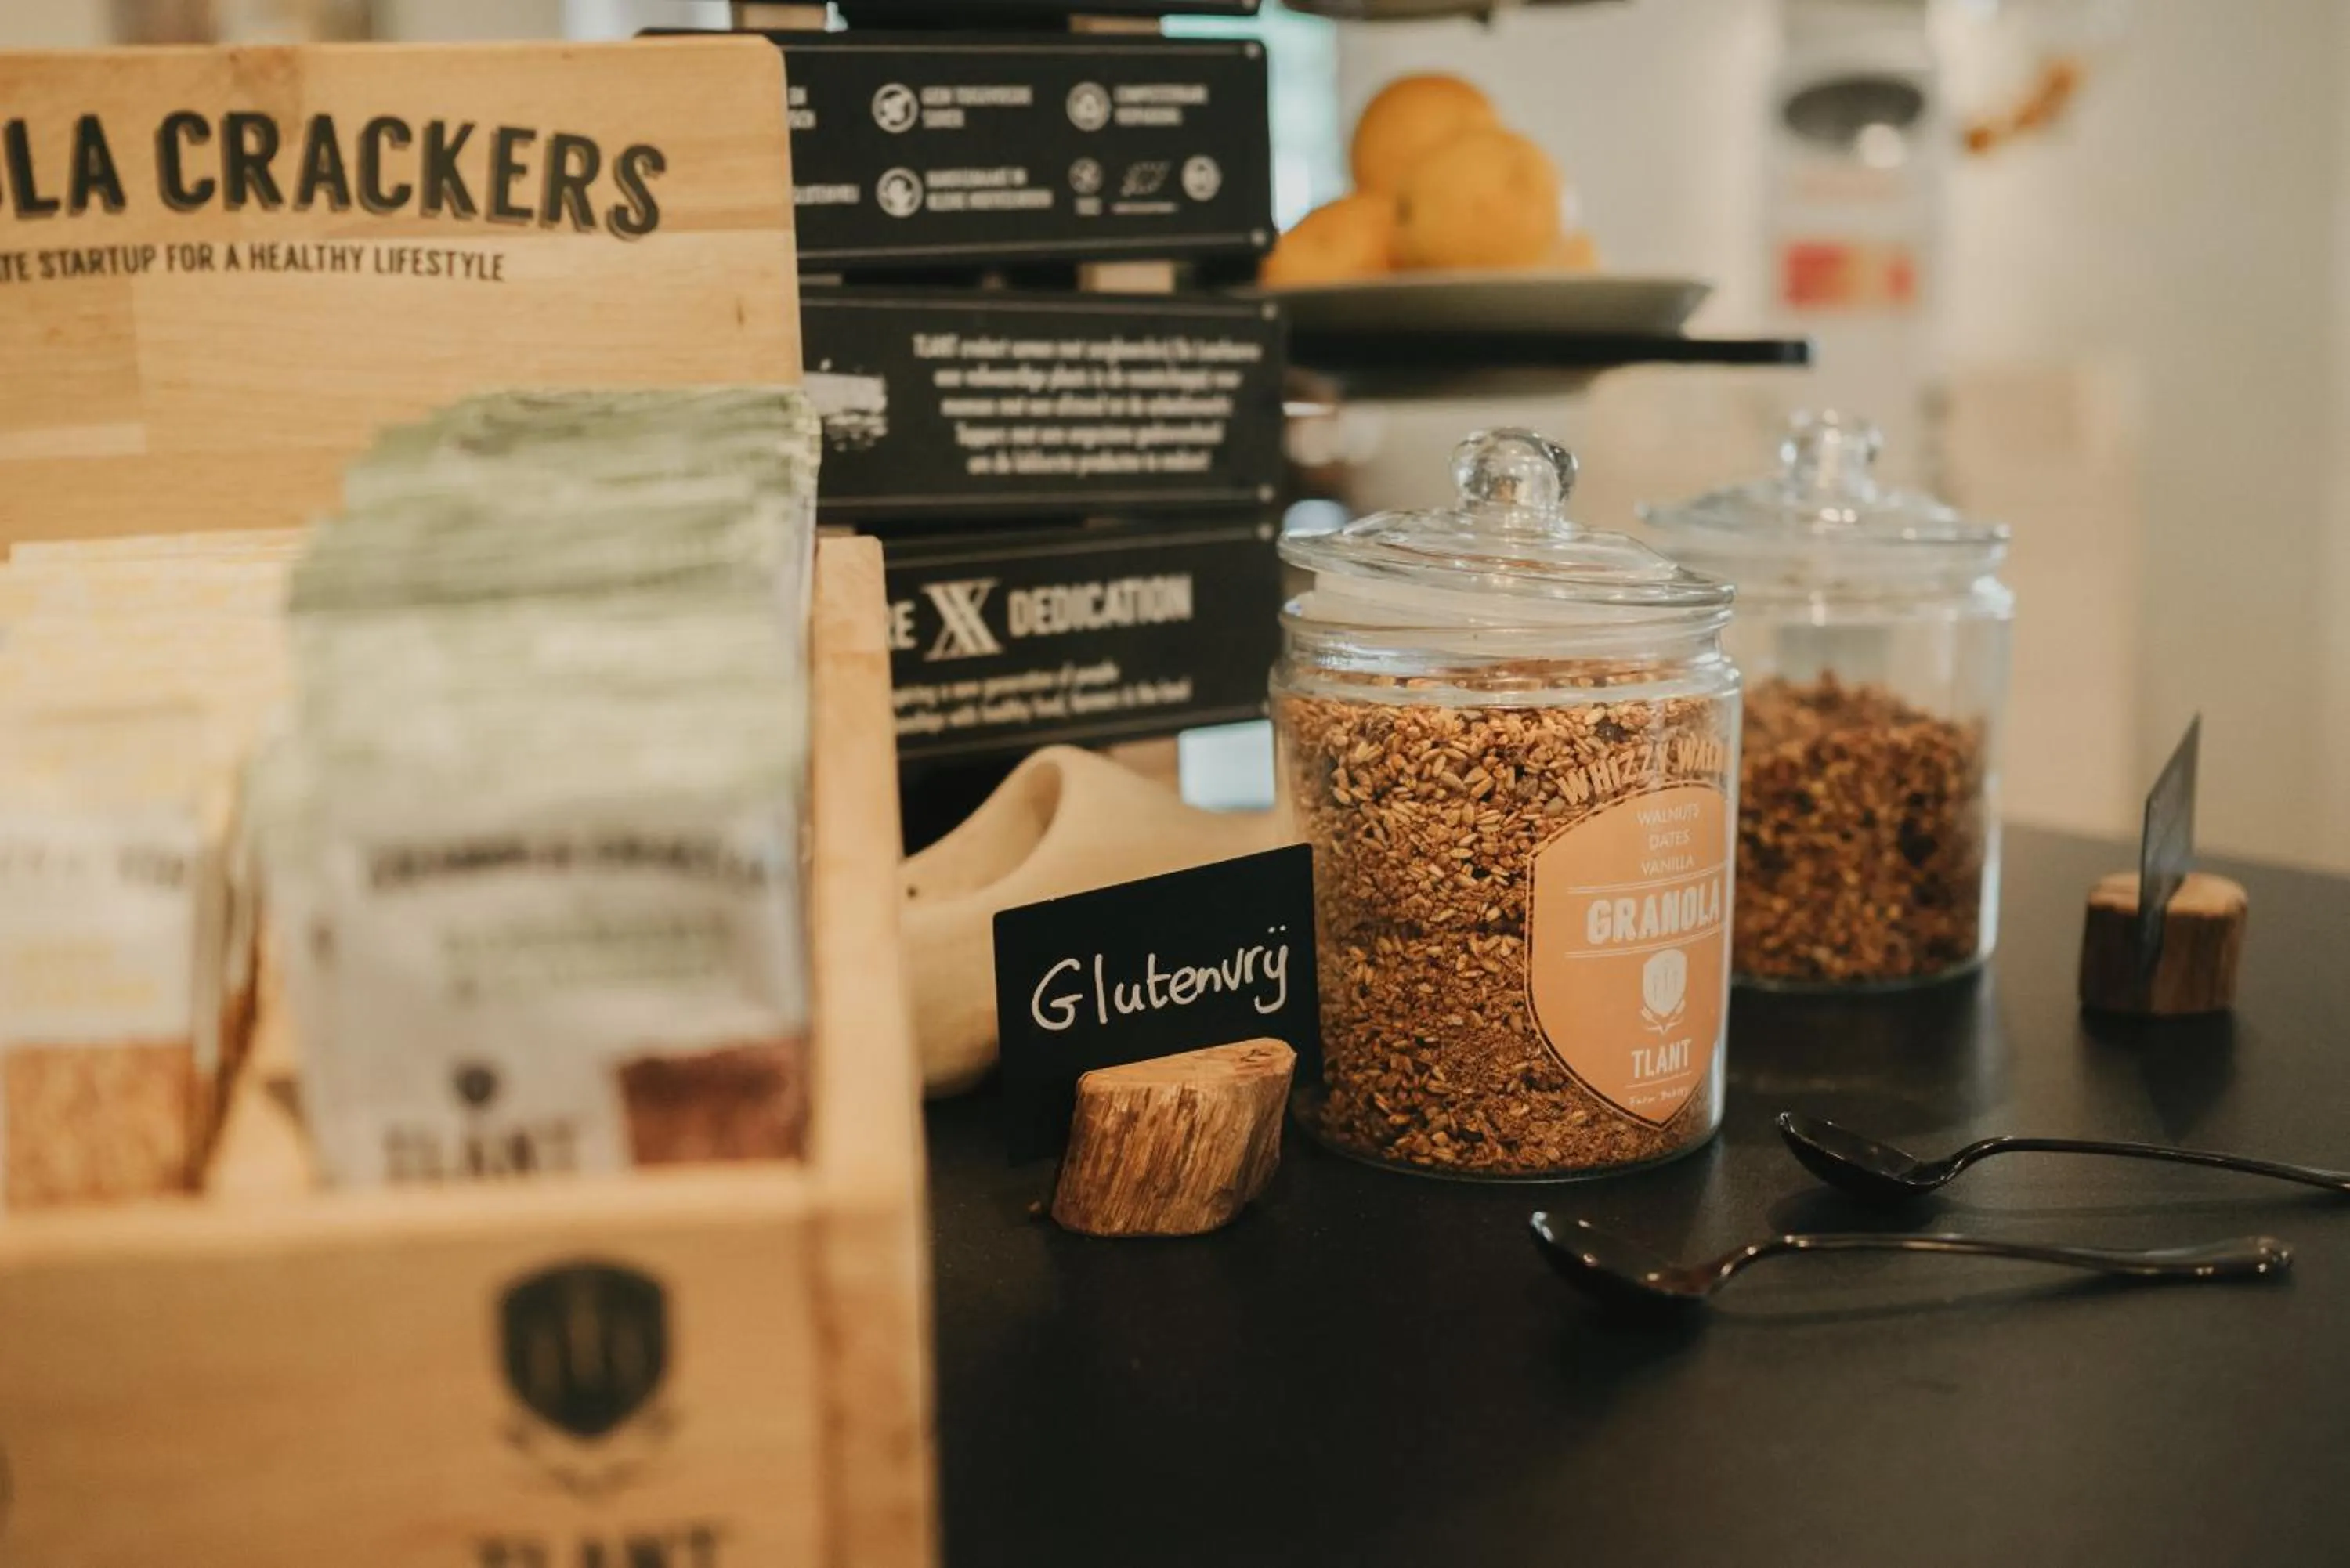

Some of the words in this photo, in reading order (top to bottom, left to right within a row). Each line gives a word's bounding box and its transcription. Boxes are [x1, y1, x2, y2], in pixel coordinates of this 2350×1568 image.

[0, 111, 126, 219] LA
[156, 110, 667, 240] CRACKERS
[38, 244, 155, 280] STARTUP
[166, 243, 215, 273] FOR
[223, 243, 242, 273] A
[248, 243, 363, 274] HEALTHY
[374, 246, 505, 282] LIFESTYLE
[1007, 573, 1194, 638] DEDICATION
[1636, 803, 1700, 826] WALNUTS
[1649, 829, 1690, 851] DATES
[1640, 854, 1695, 876] VANILLA
[1586, 877, 1720, 944] GRANOLA
[1631, 1039, 1692, 1078] TLANT
